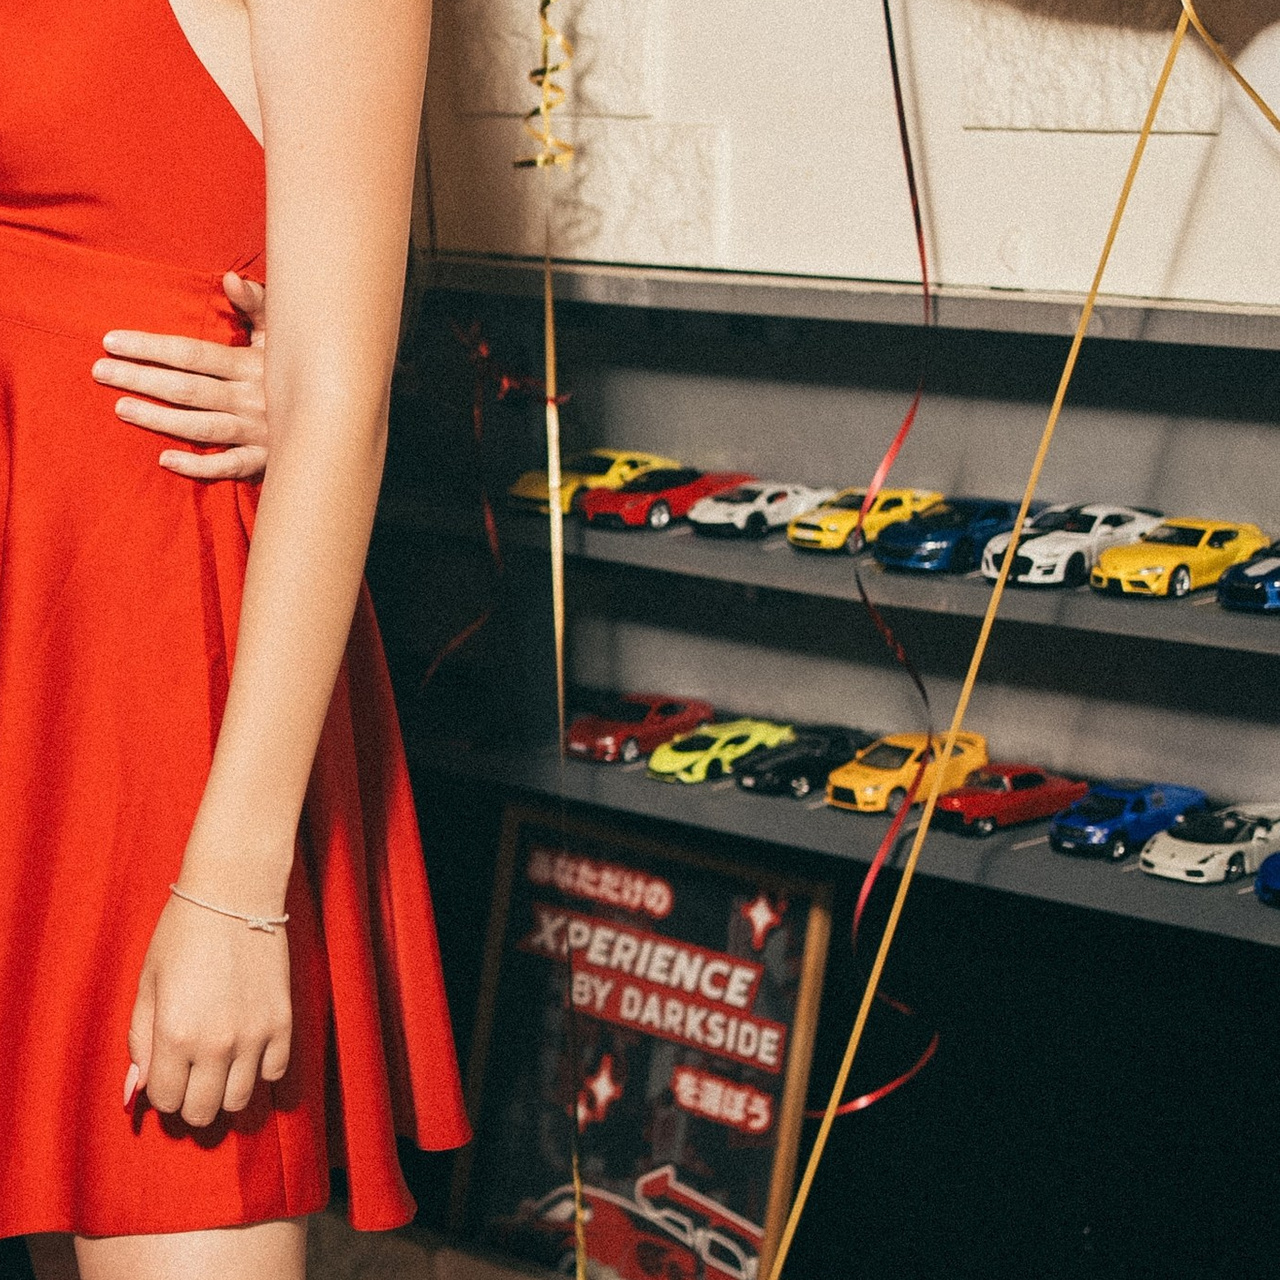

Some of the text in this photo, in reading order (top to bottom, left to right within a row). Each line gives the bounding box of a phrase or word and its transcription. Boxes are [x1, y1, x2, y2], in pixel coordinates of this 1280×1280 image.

[531, 912, 757, 1010] XPERIENCE
[571, 971, 781, 1067] BY DARKSIDE
